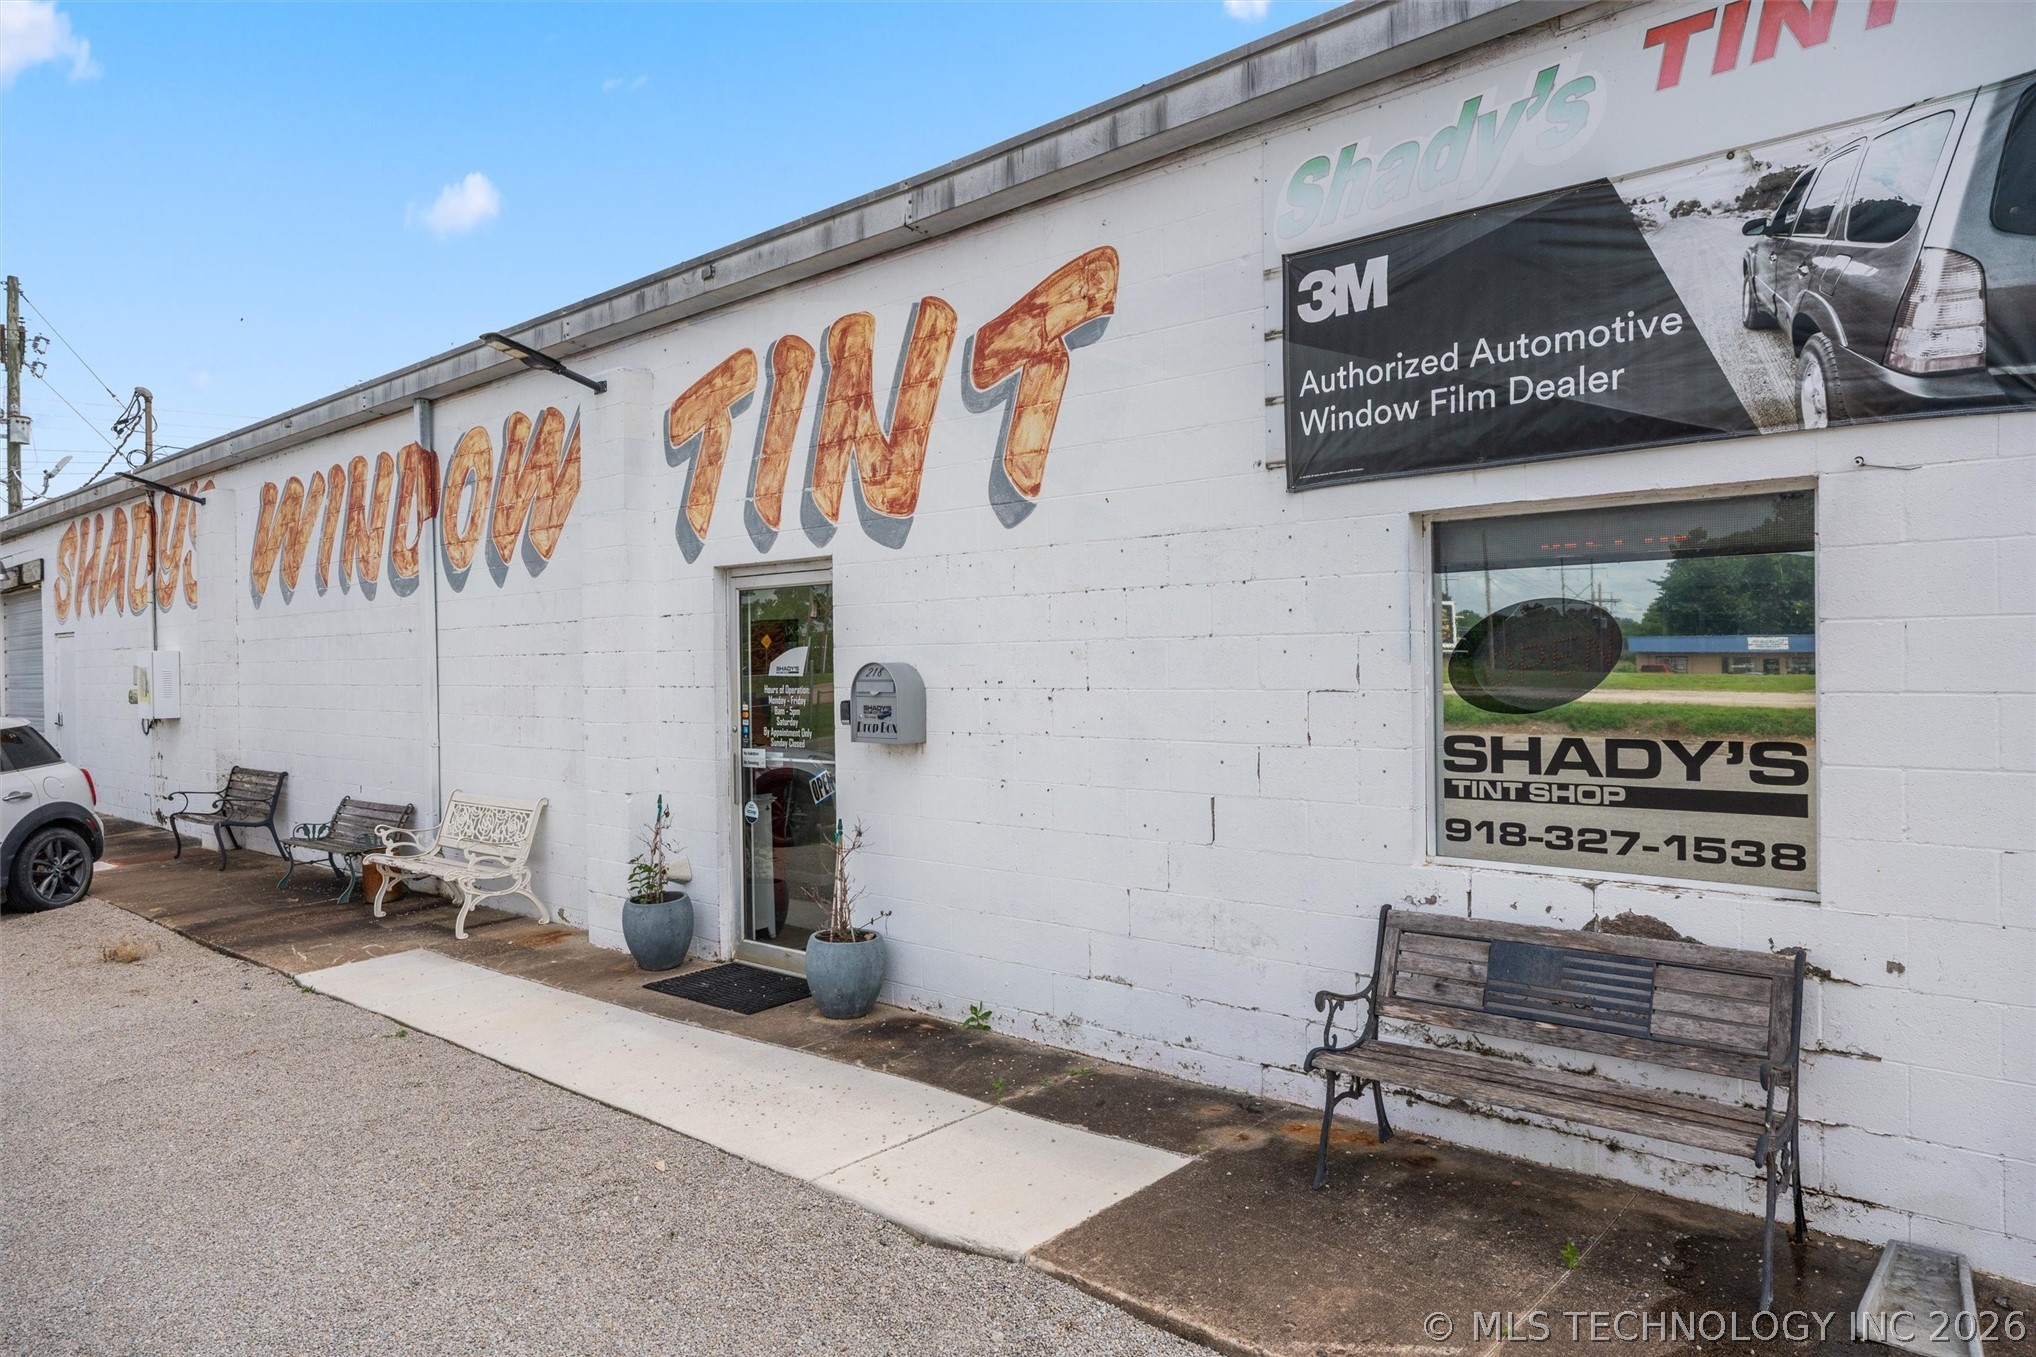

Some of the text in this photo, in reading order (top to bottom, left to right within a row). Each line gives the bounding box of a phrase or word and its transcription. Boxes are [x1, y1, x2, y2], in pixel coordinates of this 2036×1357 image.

[1277, 64, 1596, 239] Shady's
[1297, 255, 1389, 323] 3M
[1299, 311, 1683, 397] Authorized Automotive
[1299, 365, 1625, 436] Window Film Dealer
[251, 404, 582, 605] WINDOW
[665, 245, 1120, 555] TINT
[1485, 628, 1617, 687] OPEN
[866, 667, 884, 677] 218
[764, 685, 810, 696] Hours of Operation:
[768, 696, 786, 706] Monday
[790, 696, 806, 706] Friday
[774, 706, 785, 715] 8am
[789, 706, 800, 717] 5pm
[776, 717, 798, 727] Saturday
[763, 727, 812, 739] By Appointment Only
[857, 721, 897, 734] Drop Box
[771, 739, 805, 749] Sunday Closed
[1443, 735, 1810, 787] SHADY'S
[1451, 779, 1627, 806] TINT SHOP
[1445, 818, 1807, 872] 918-327-1538
